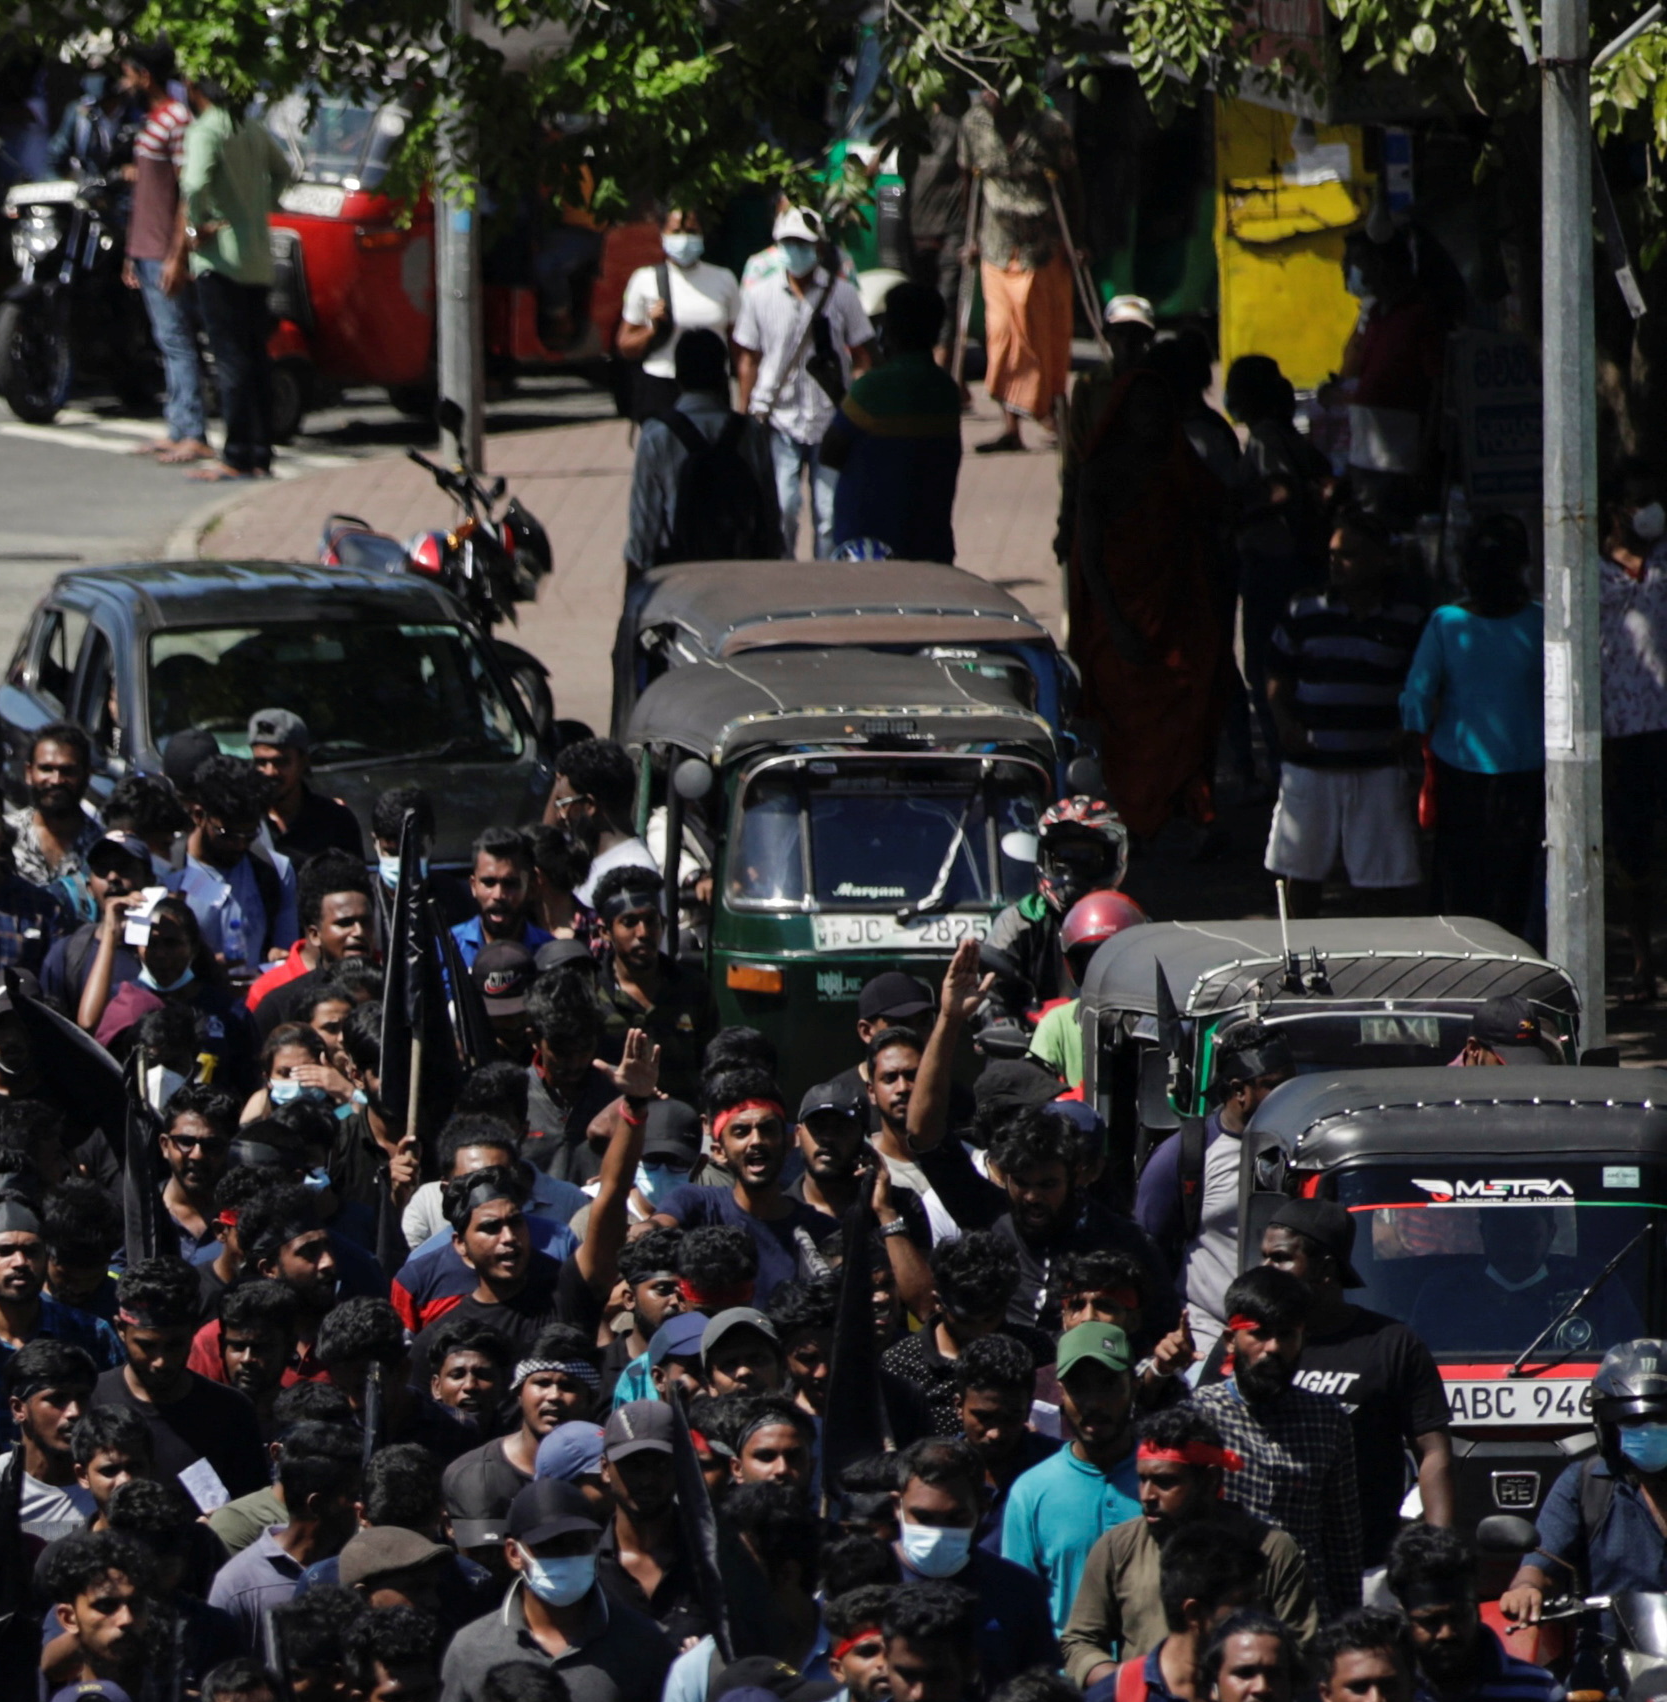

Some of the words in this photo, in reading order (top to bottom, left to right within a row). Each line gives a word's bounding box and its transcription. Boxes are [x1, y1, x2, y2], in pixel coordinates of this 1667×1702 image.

[832, 882, 906, 898] Maryam
[847, 919, 883, 943] JC
[919, 918, 989, 943] 2825
[1367, 1018, 1434, 1041] TAXI
[1456, 1179, 1574, 1196] METRA
[1450, 1386, 1516, 1420] ABC
[1533, 1386, 1595, 1419] 946
